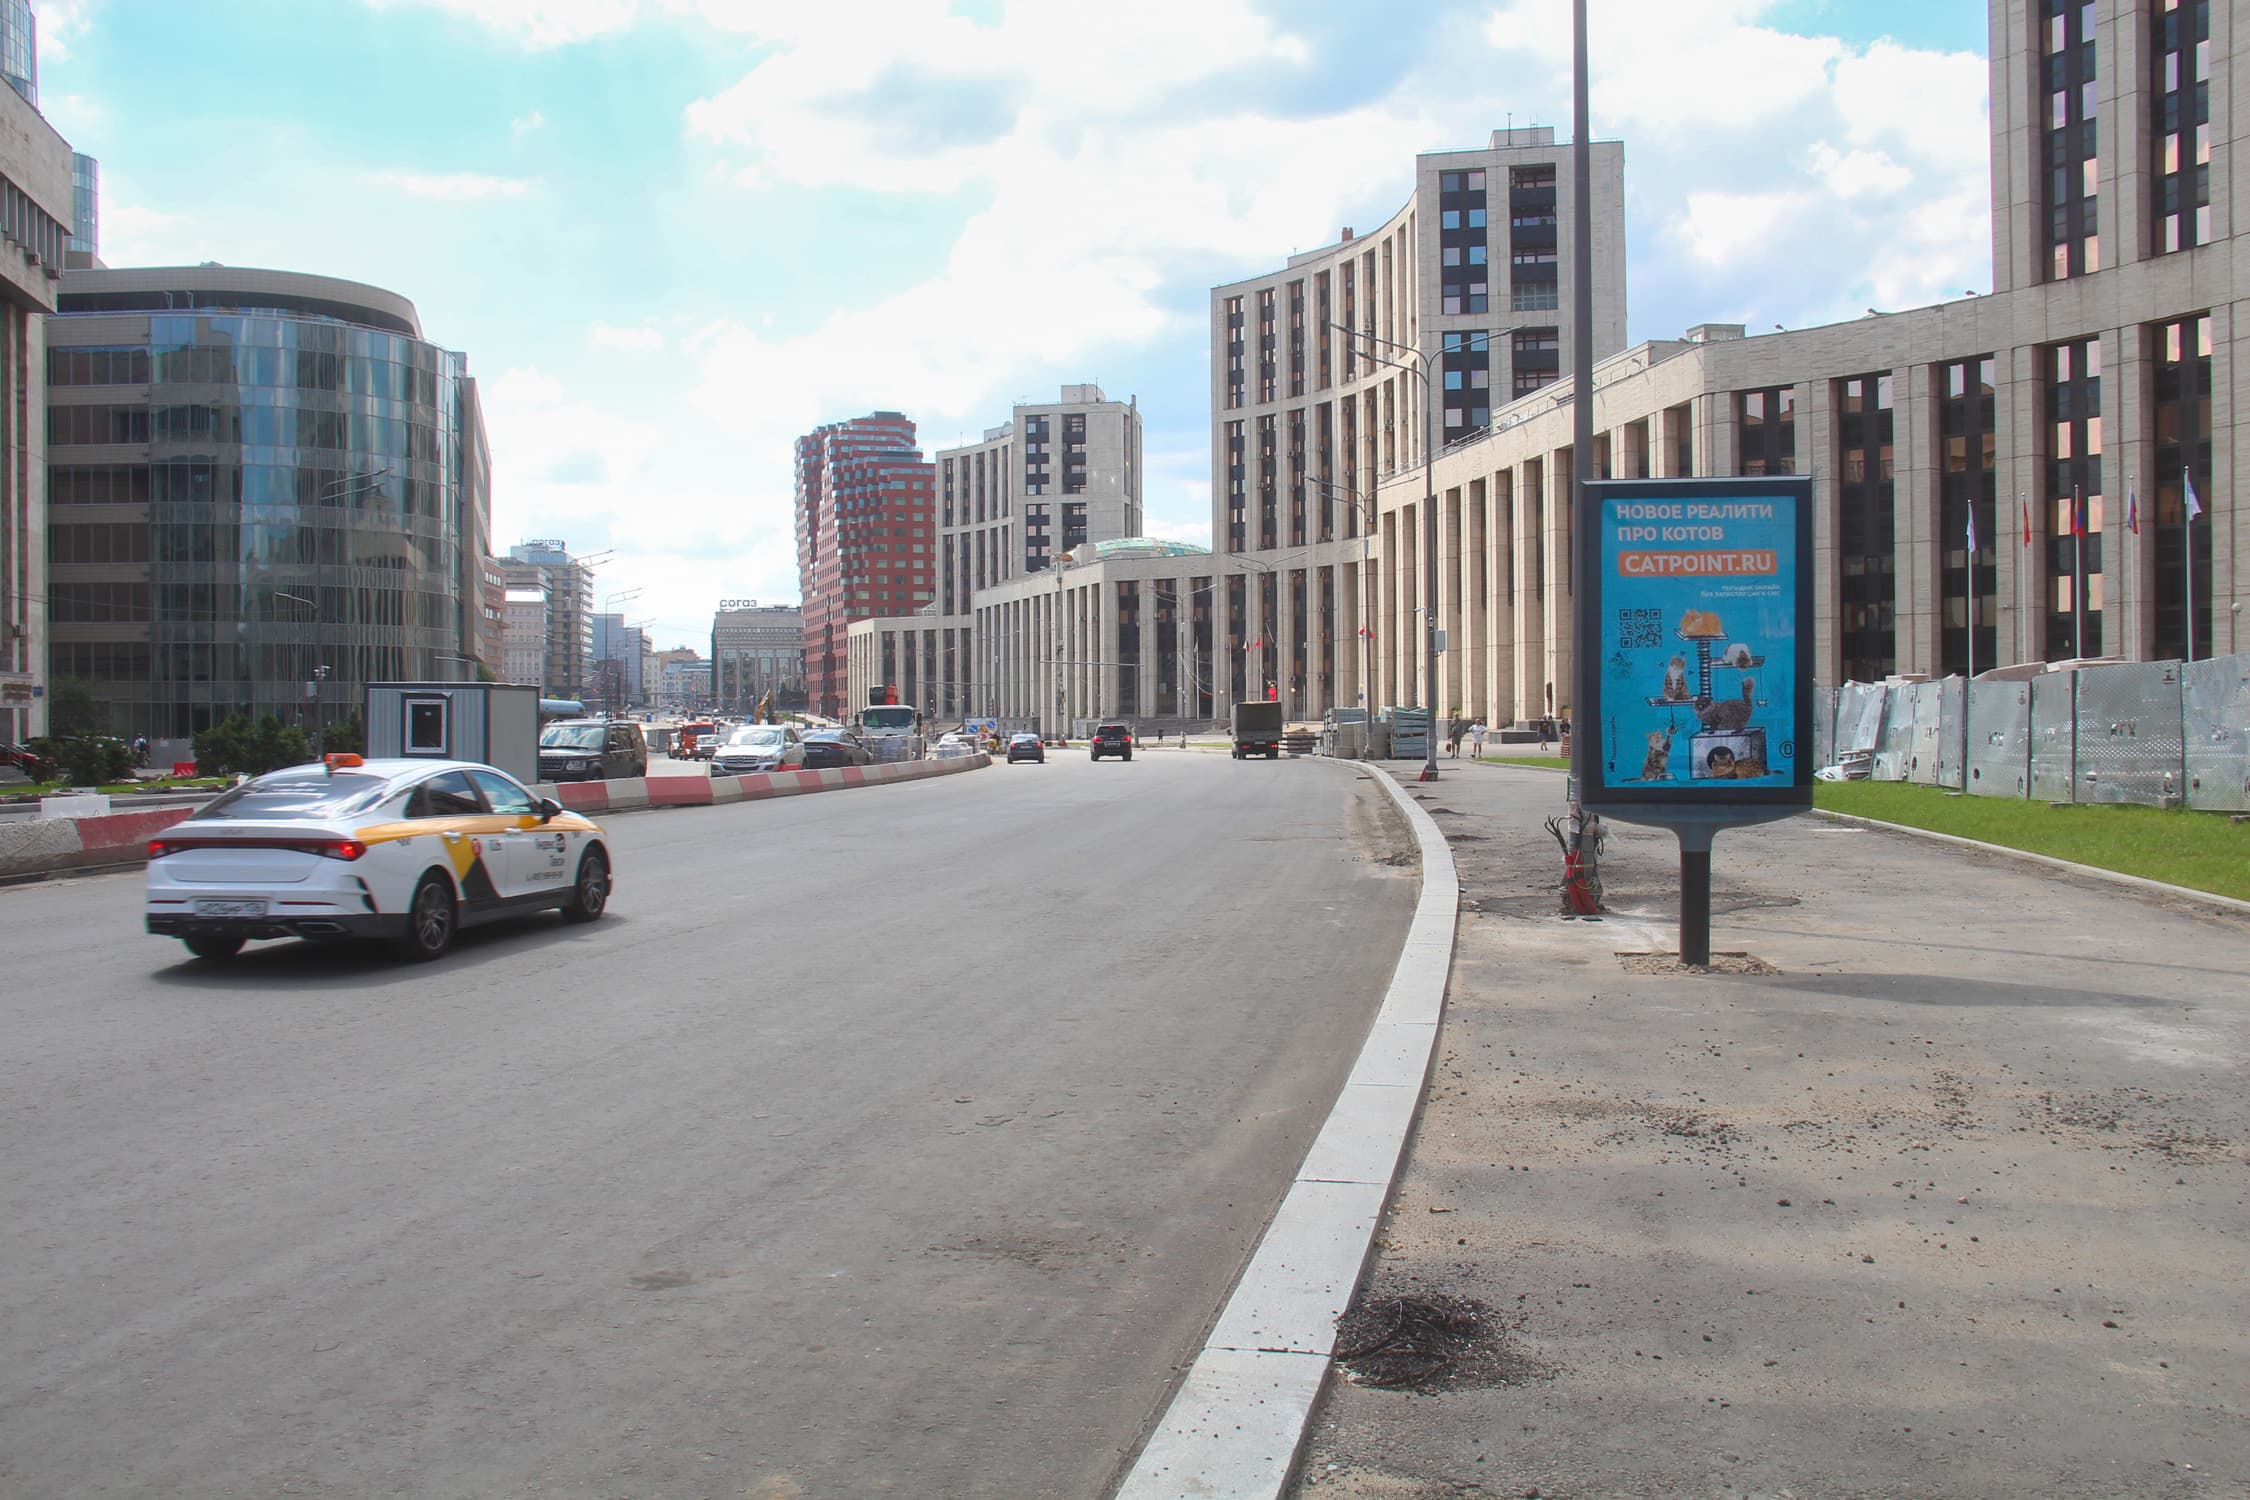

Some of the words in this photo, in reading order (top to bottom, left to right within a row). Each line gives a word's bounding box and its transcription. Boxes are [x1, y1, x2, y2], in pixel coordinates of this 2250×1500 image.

[1616, 504, 1683, 520] НОВОЕ
[1687, 504, 1774, 519] РЕАЛИТИ
[1618, 526, 1657, 541] ПРО
[1662, 526, 1724, 541] КОТОВ
[1624, 553, 1771, 573] CATPOINT.RU
[719, 599, 758, 608] согаз
